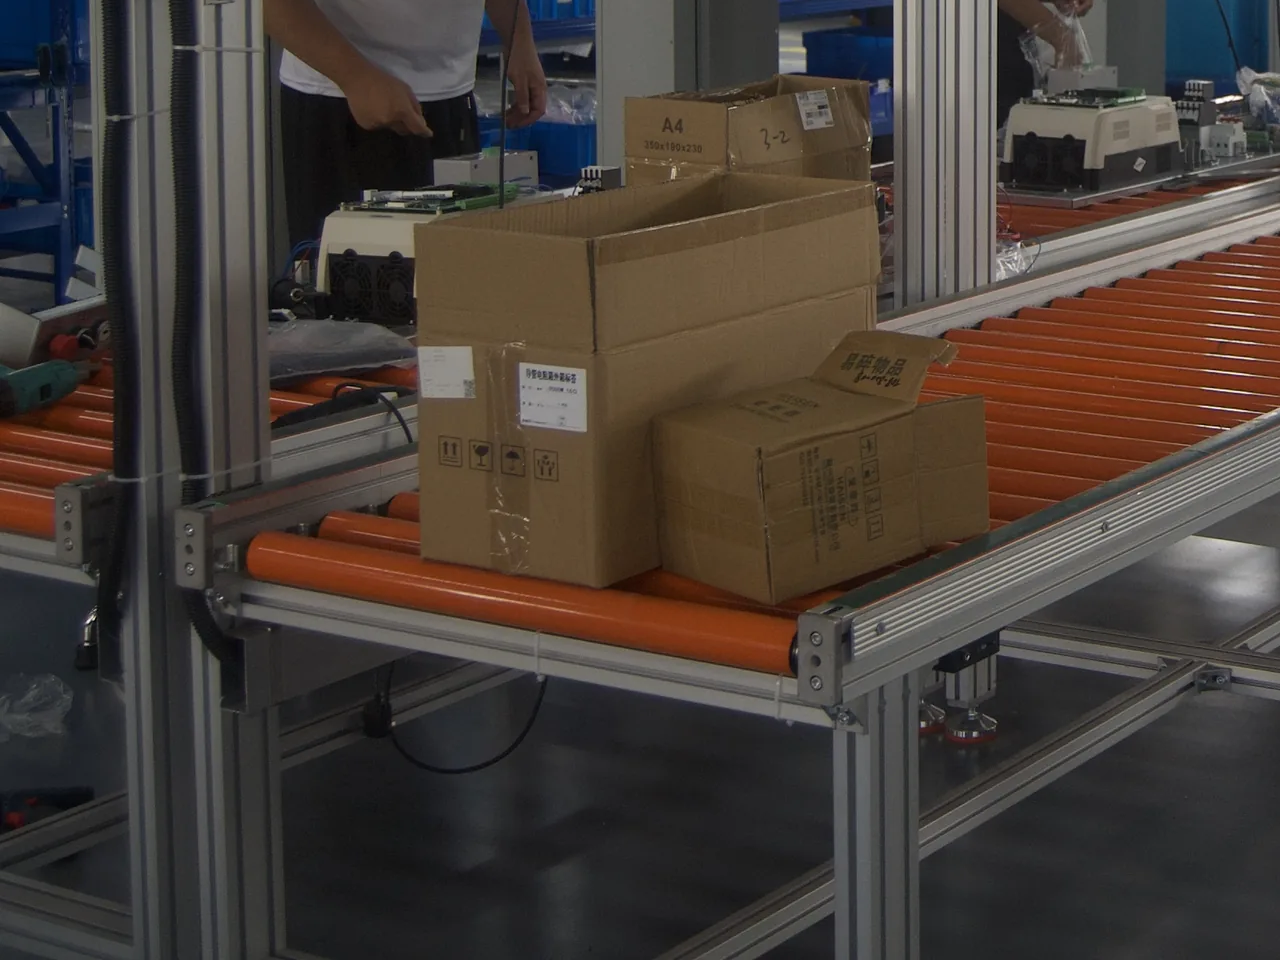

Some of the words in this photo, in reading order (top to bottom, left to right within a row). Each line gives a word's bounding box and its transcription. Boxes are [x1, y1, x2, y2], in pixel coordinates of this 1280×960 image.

[661, 117, 684, 134] A4
[840, 353, 907, 376] 易碎物品
